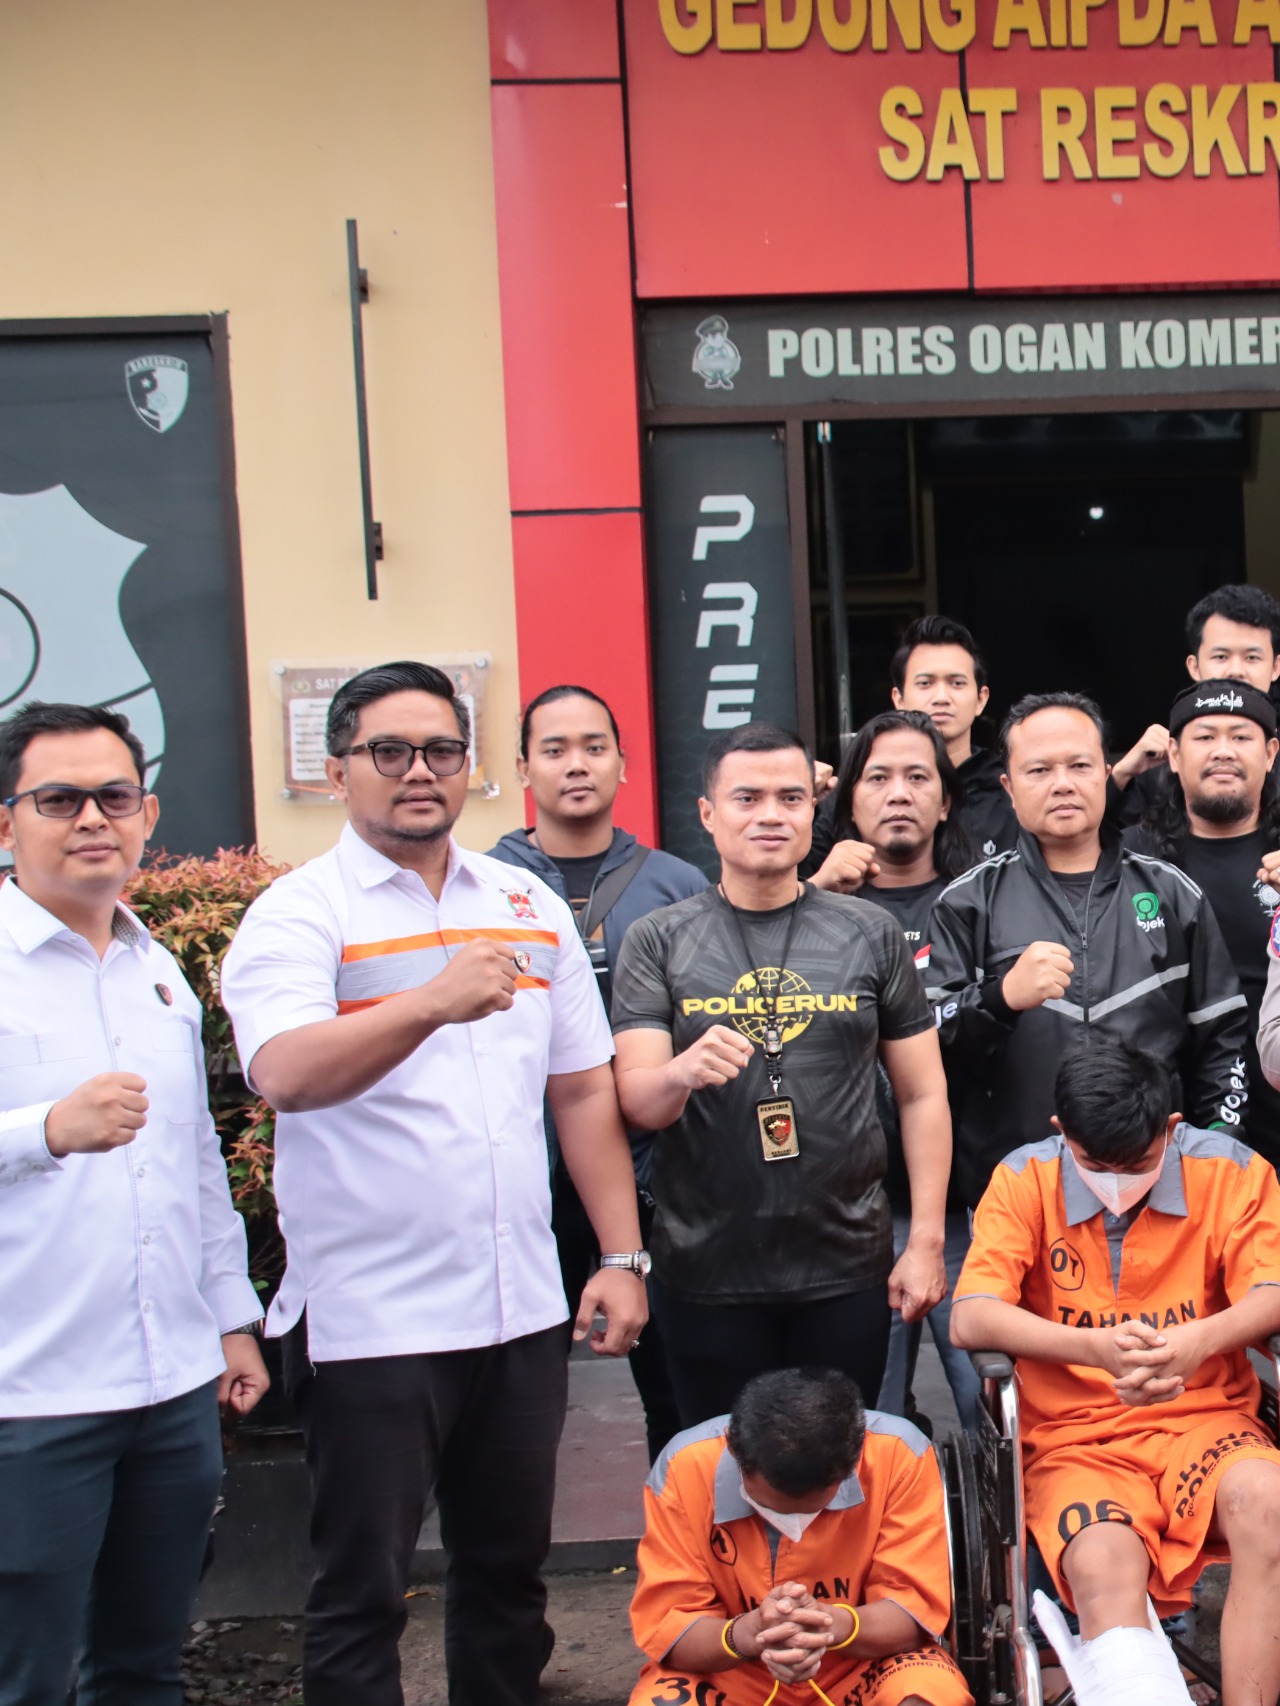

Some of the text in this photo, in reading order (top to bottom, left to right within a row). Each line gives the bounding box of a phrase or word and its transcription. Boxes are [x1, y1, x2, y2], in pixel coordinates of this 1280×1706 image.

[878, 86, 1017, 181] SAT
[767, 326, 957, 378] POLRES
[968, 321, 1106, 374] OGAN
[682, 994, 858, 1016] POLICERUN
[1221, 1056, 1248, 1126] gojek
[1058, 1499, 1133, 1544] 06
